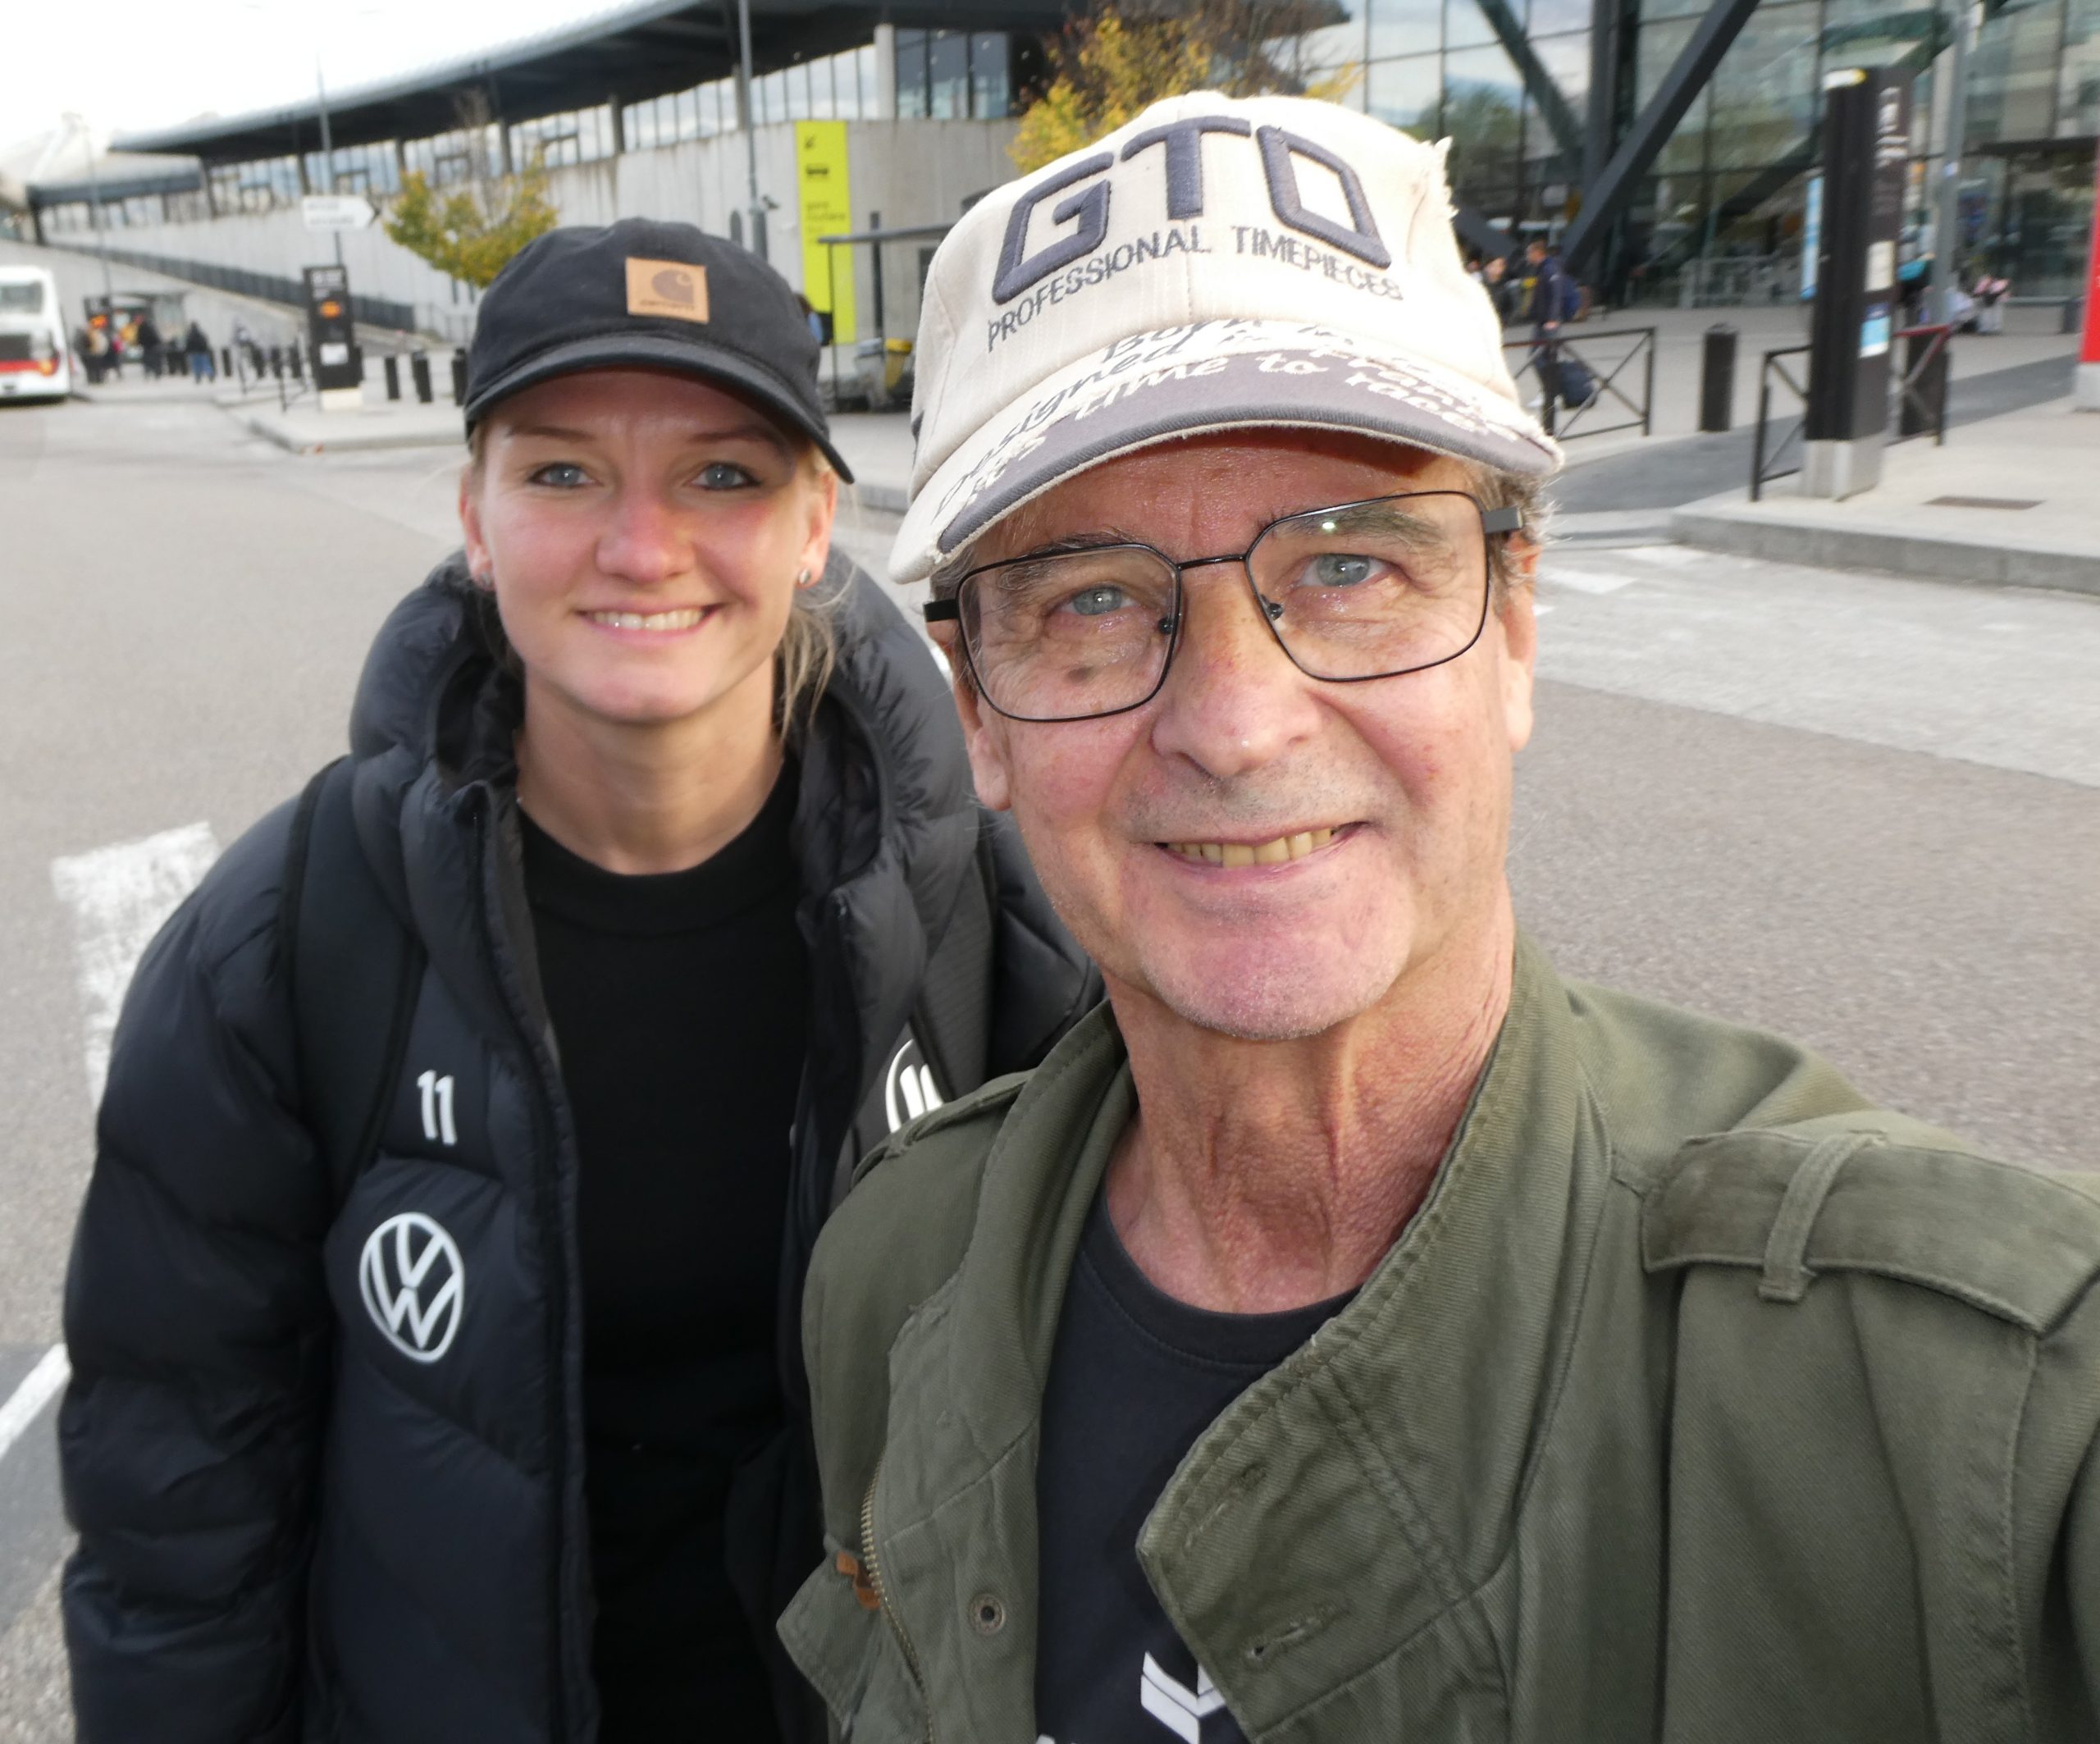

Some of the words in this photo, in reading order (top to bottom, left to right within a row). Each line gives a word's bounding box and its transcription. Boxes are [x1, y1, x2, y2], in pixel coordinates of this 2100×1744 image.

[992, 115, 1392, 305] GTO
[987, 224, 1212, 353] PROFESSIONAL
[1230, 225, 1404, 301] TIMEPIECES
[1255, 352, 1330, 375] to
[417, 1069, 457, 1146] 11
